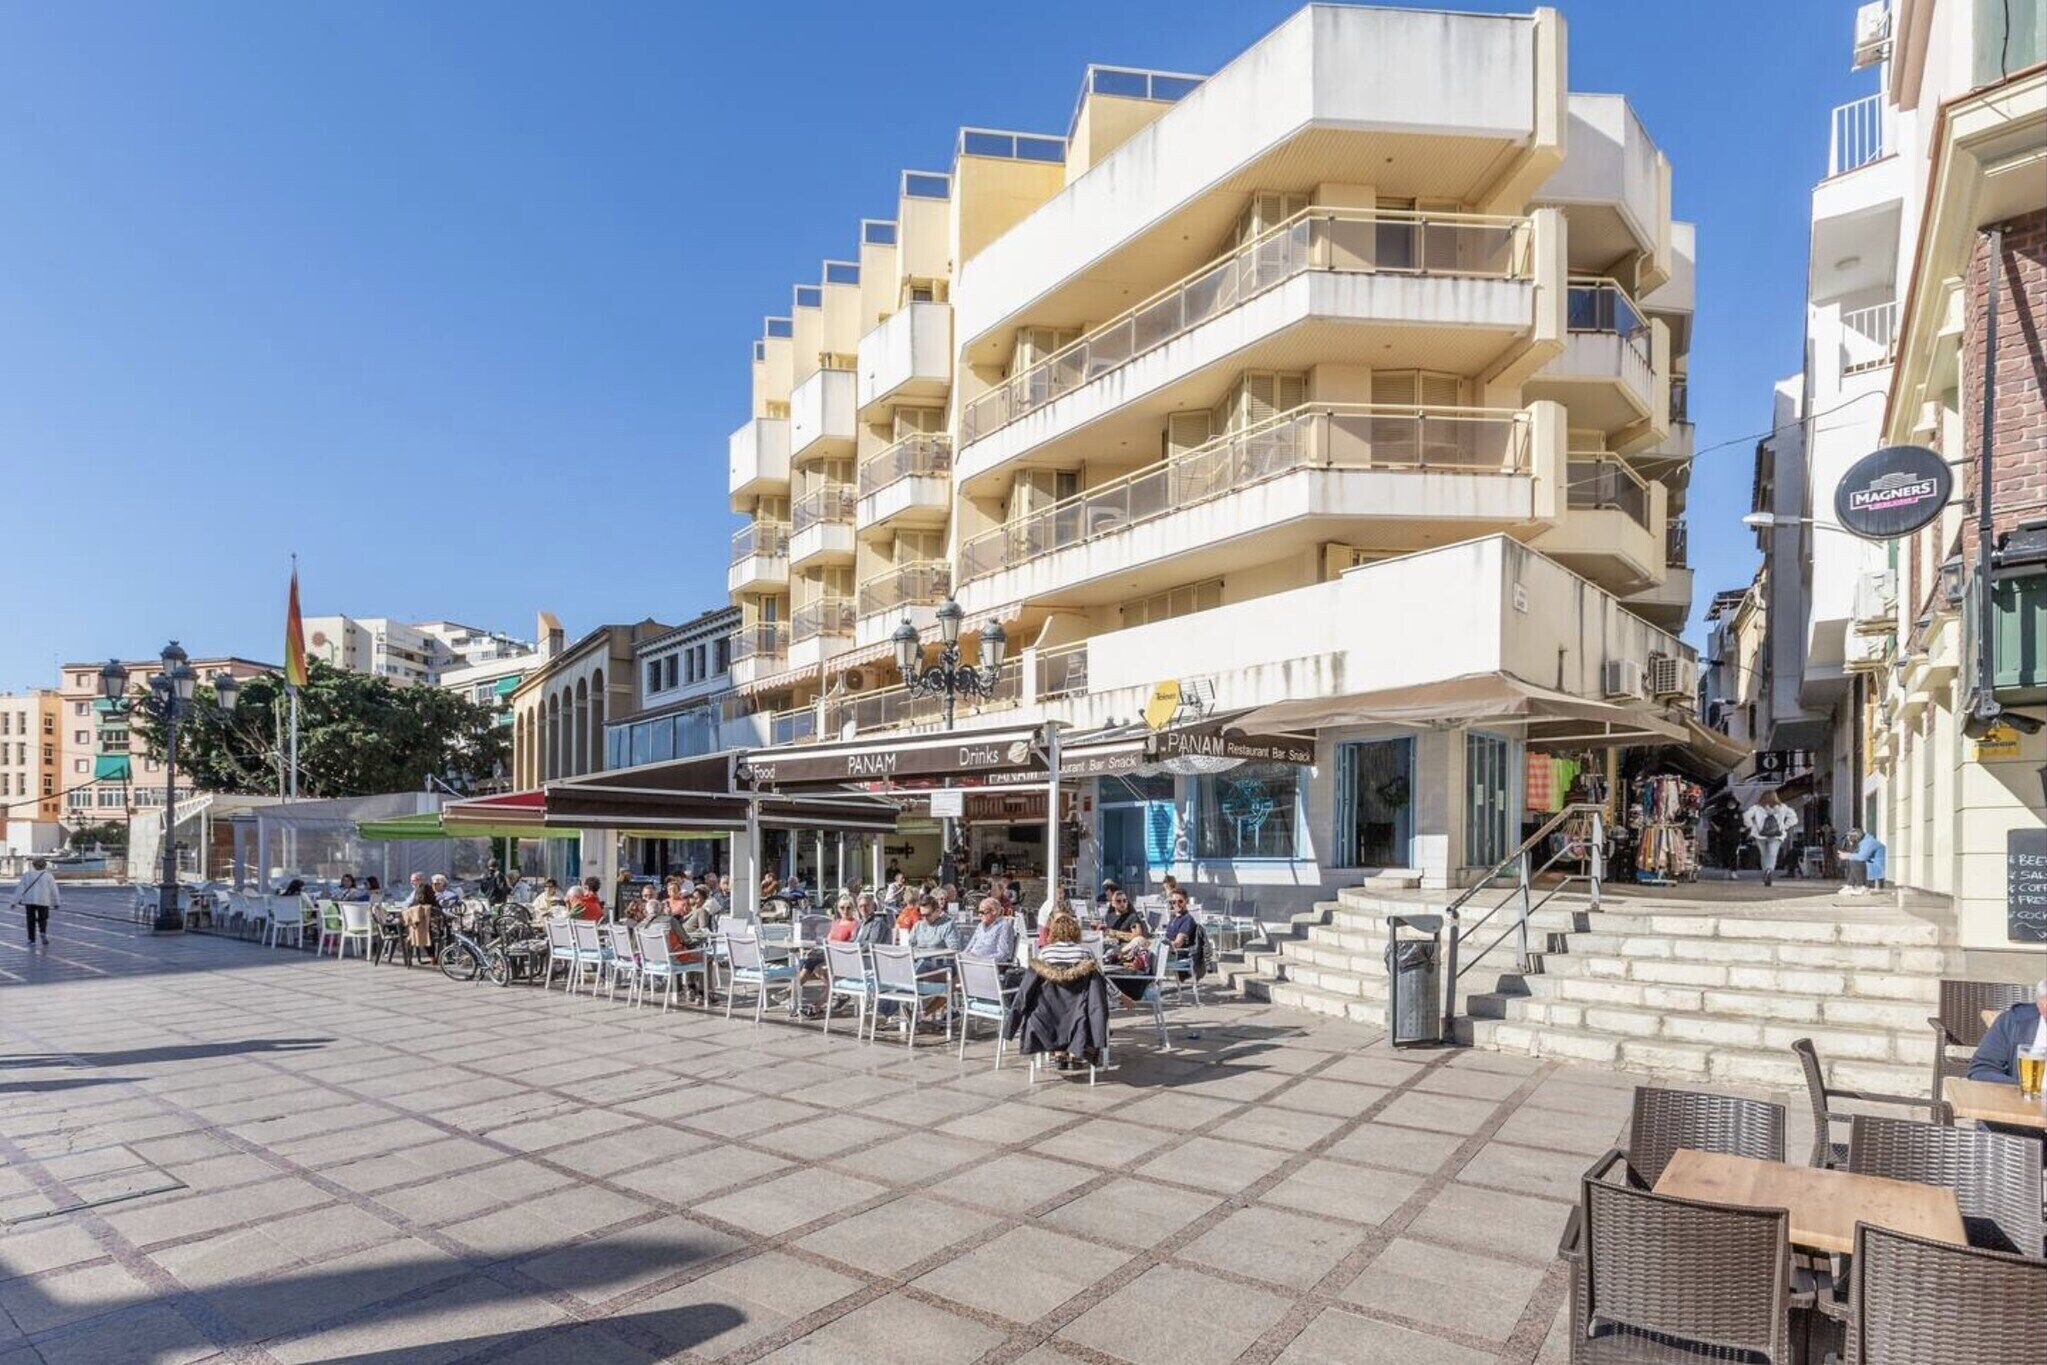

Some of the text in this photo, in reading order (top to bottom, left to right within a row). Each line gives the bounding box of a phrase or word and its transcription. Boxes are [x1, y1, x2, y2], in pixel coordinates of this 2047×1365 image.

[1855, 482, 1932, 505] MAGNERS
[1168, 733, 1311, 762] PANAM Restaurant Bar Snack
[848, 752, 897, 775] PANAM
[959, 745, 1000, 766] Drinks
[1089, 759, 1105, 772] Bar
[1108, 754, 1137, 769] Snack
[2018, 853, 2047, 867] BEE
